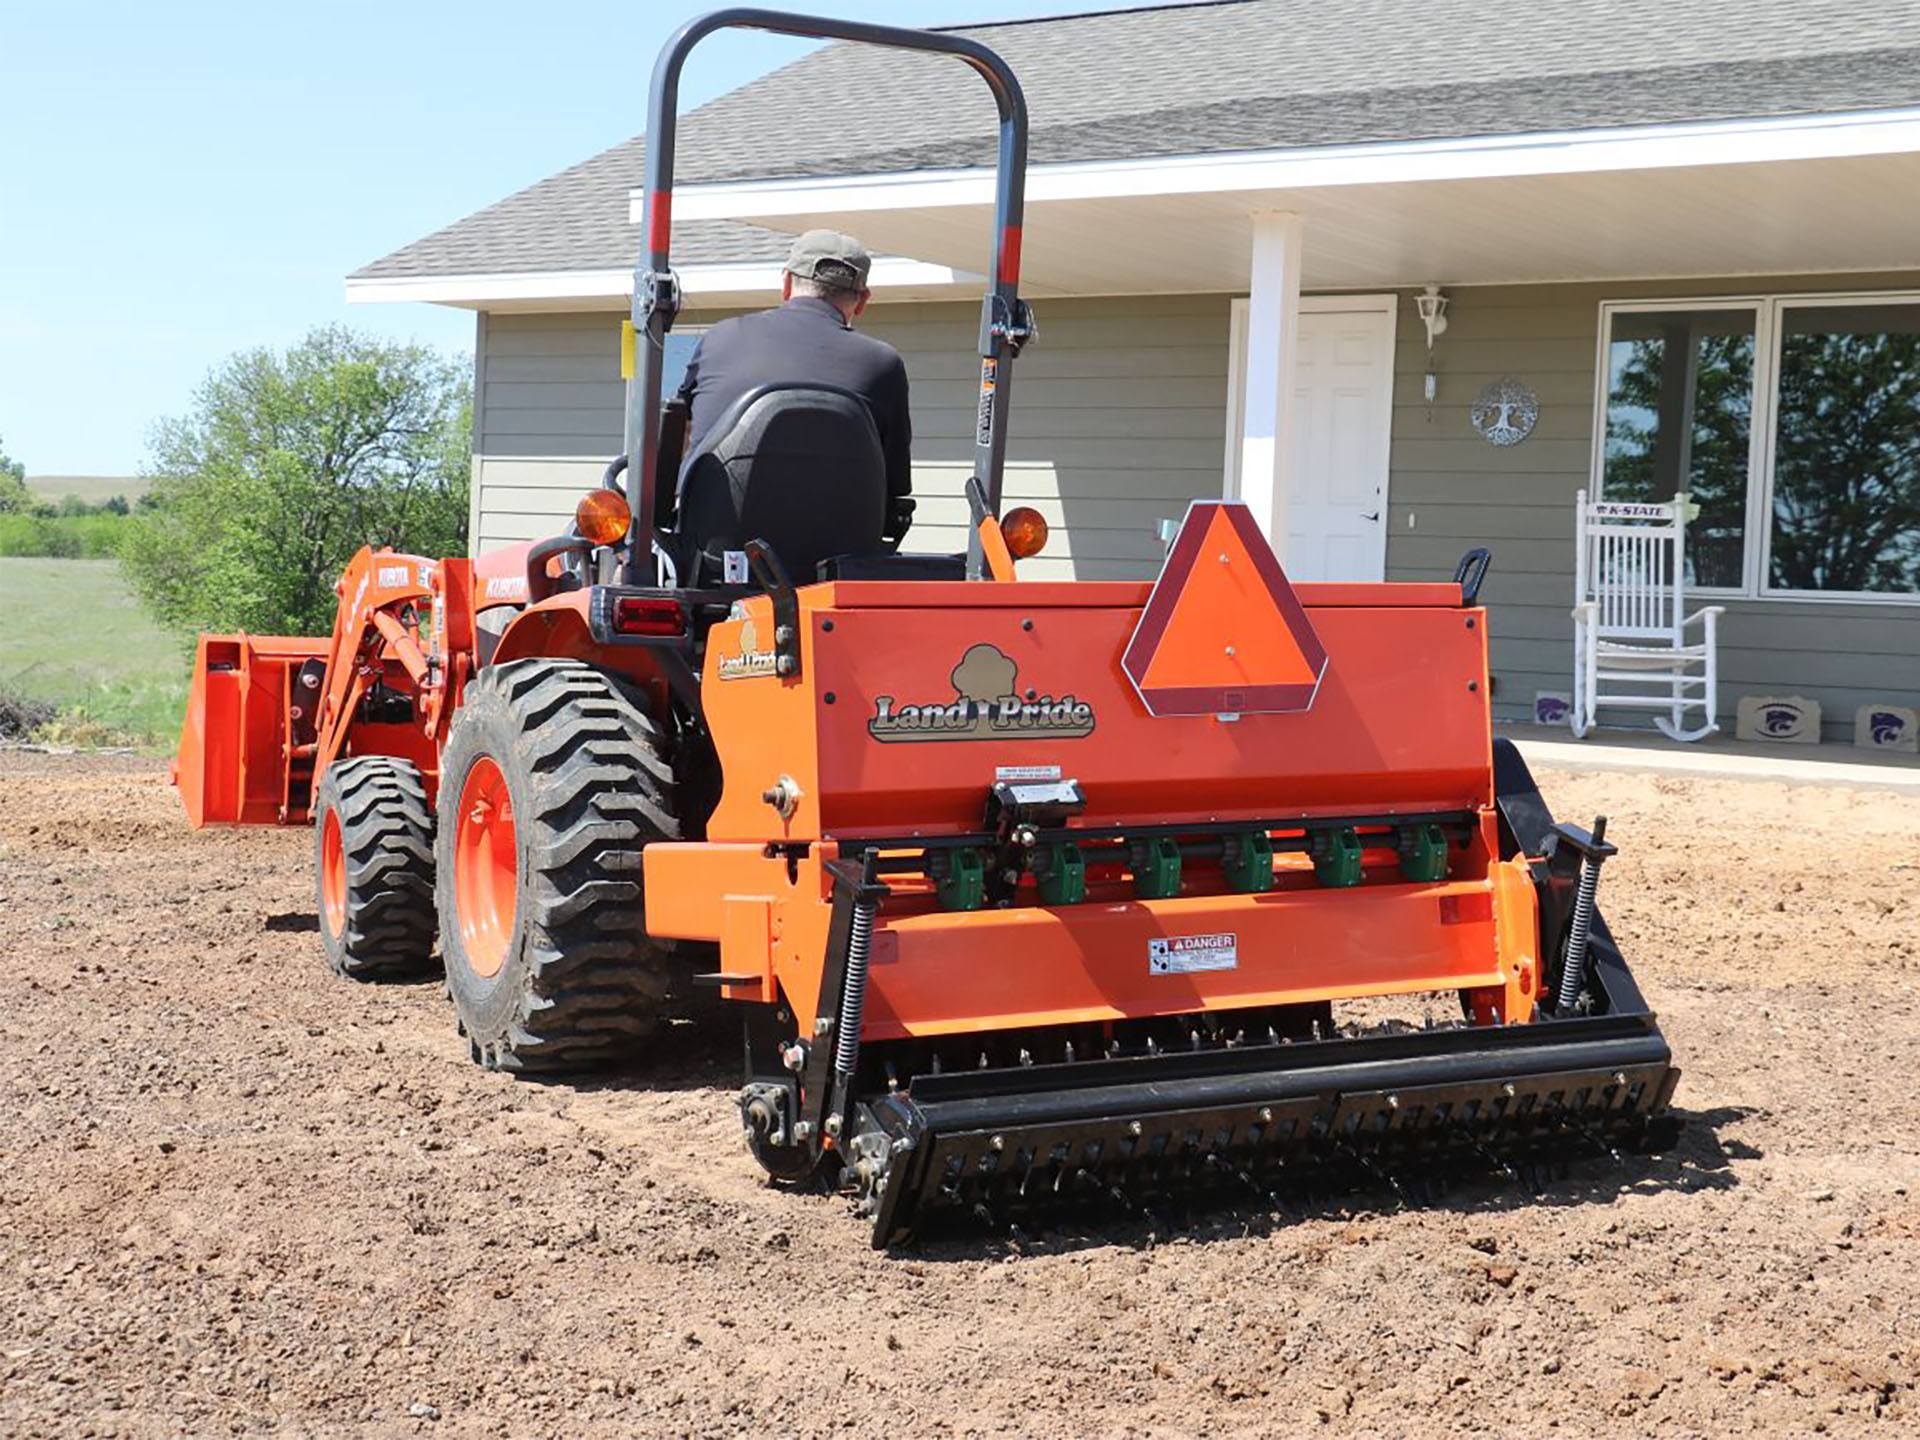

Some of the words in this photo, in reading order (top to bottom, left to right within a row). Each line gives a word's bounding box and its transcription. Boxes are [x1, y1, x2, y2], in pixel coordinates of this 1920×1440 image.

[1608, 505, 1665, 517] K-STATE
[874, 696, 970, 729] Land
[992, 696, 1092, 728] Pride
[1185, 936, 1232, 949] DANGER
